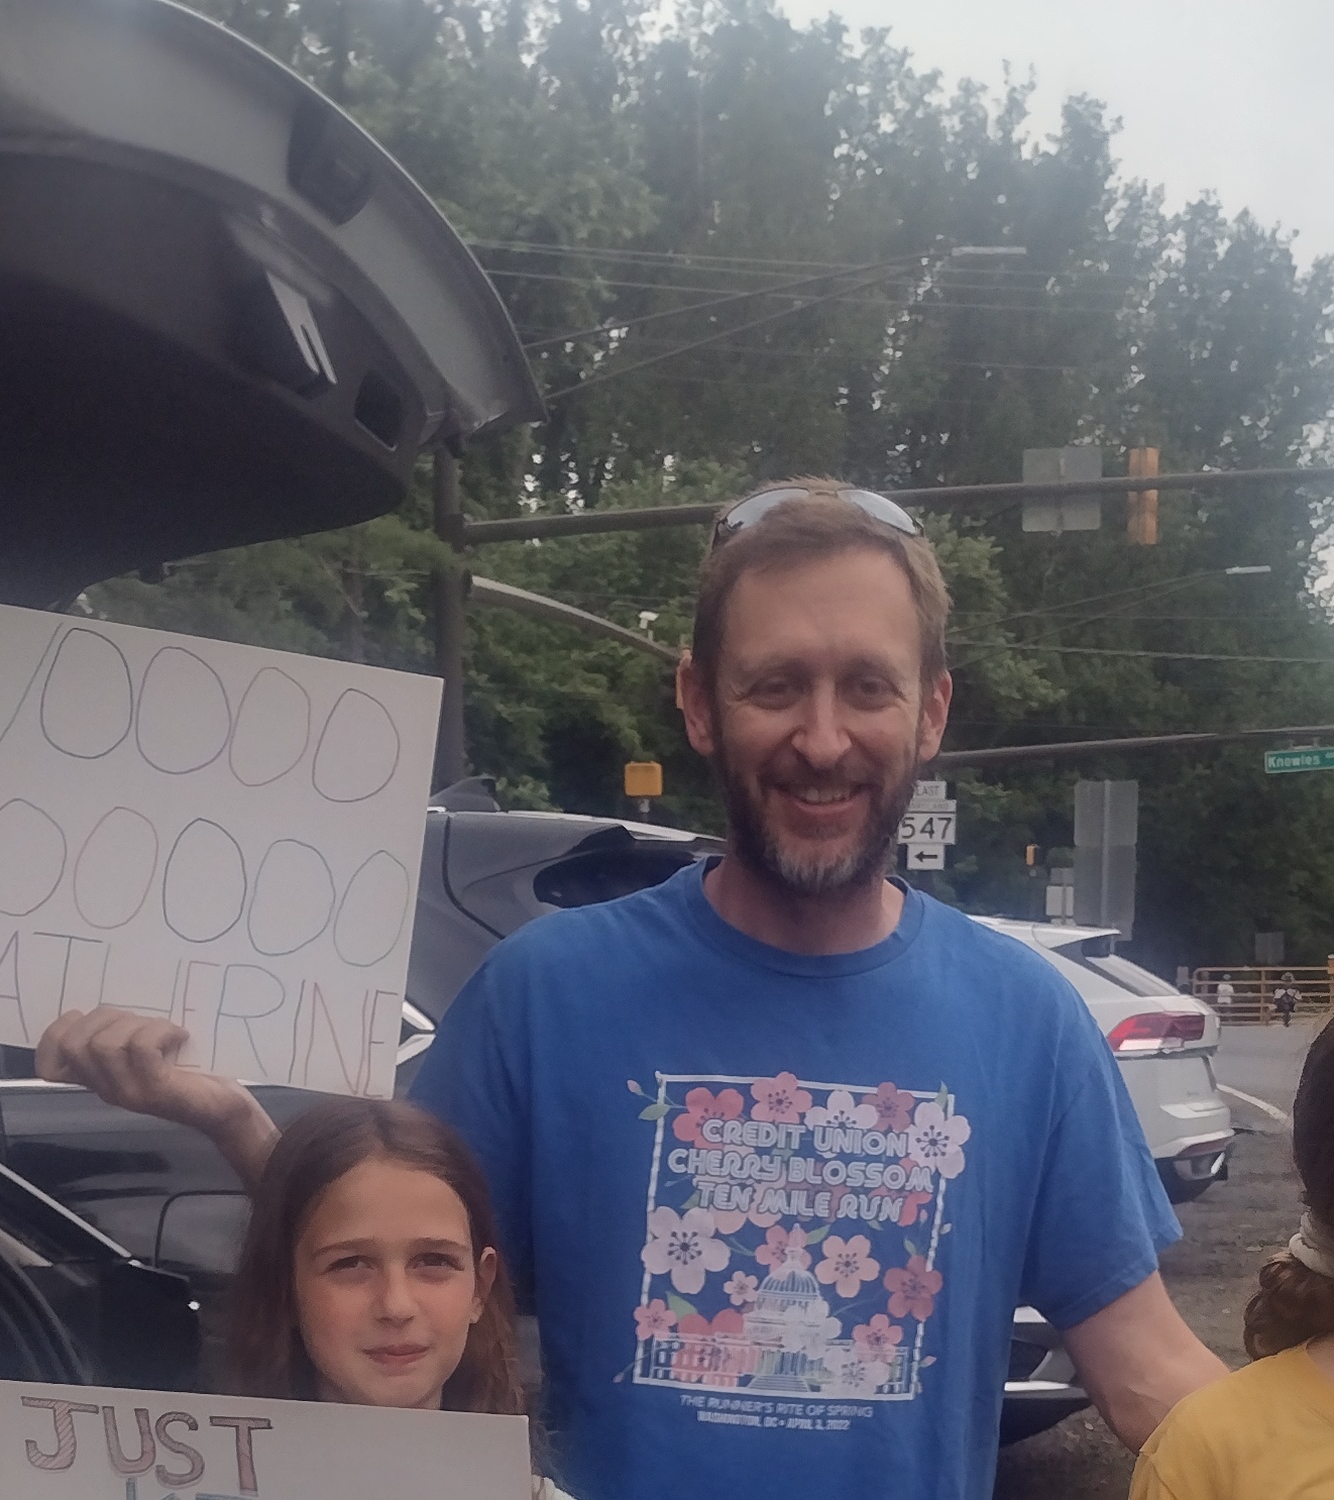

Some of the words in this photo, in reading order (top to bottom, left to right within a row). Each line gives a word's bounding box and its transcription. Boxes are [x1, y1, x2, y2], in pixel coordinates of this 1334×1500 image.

[1267, 754, 1321, 768] Knowles
[901, 816, 953, 840] 547
[702, 1119, 806, 1150] CREDIT
[813, 1124, 909, 1157] UNION
[667, 1148, 783, 1182] CHERRY
[787, 1156, 934, 1193] BLOSSOM
[695, 1181, 753, 1211] TEN
[757, 1187, 832, 1217] MILE
[837, 1193, 905, 1222] RUN
[679, 1394, 706, 1408] THE
[707, 1397, 773, 1415] RUNNER'S
[775, 1402, 804, 1416] RITE
[805, 1404, 826, 1416] OF
[827, 1405, 874, 1418] SPRING
[20, 1395, 274, 1497] JUST
